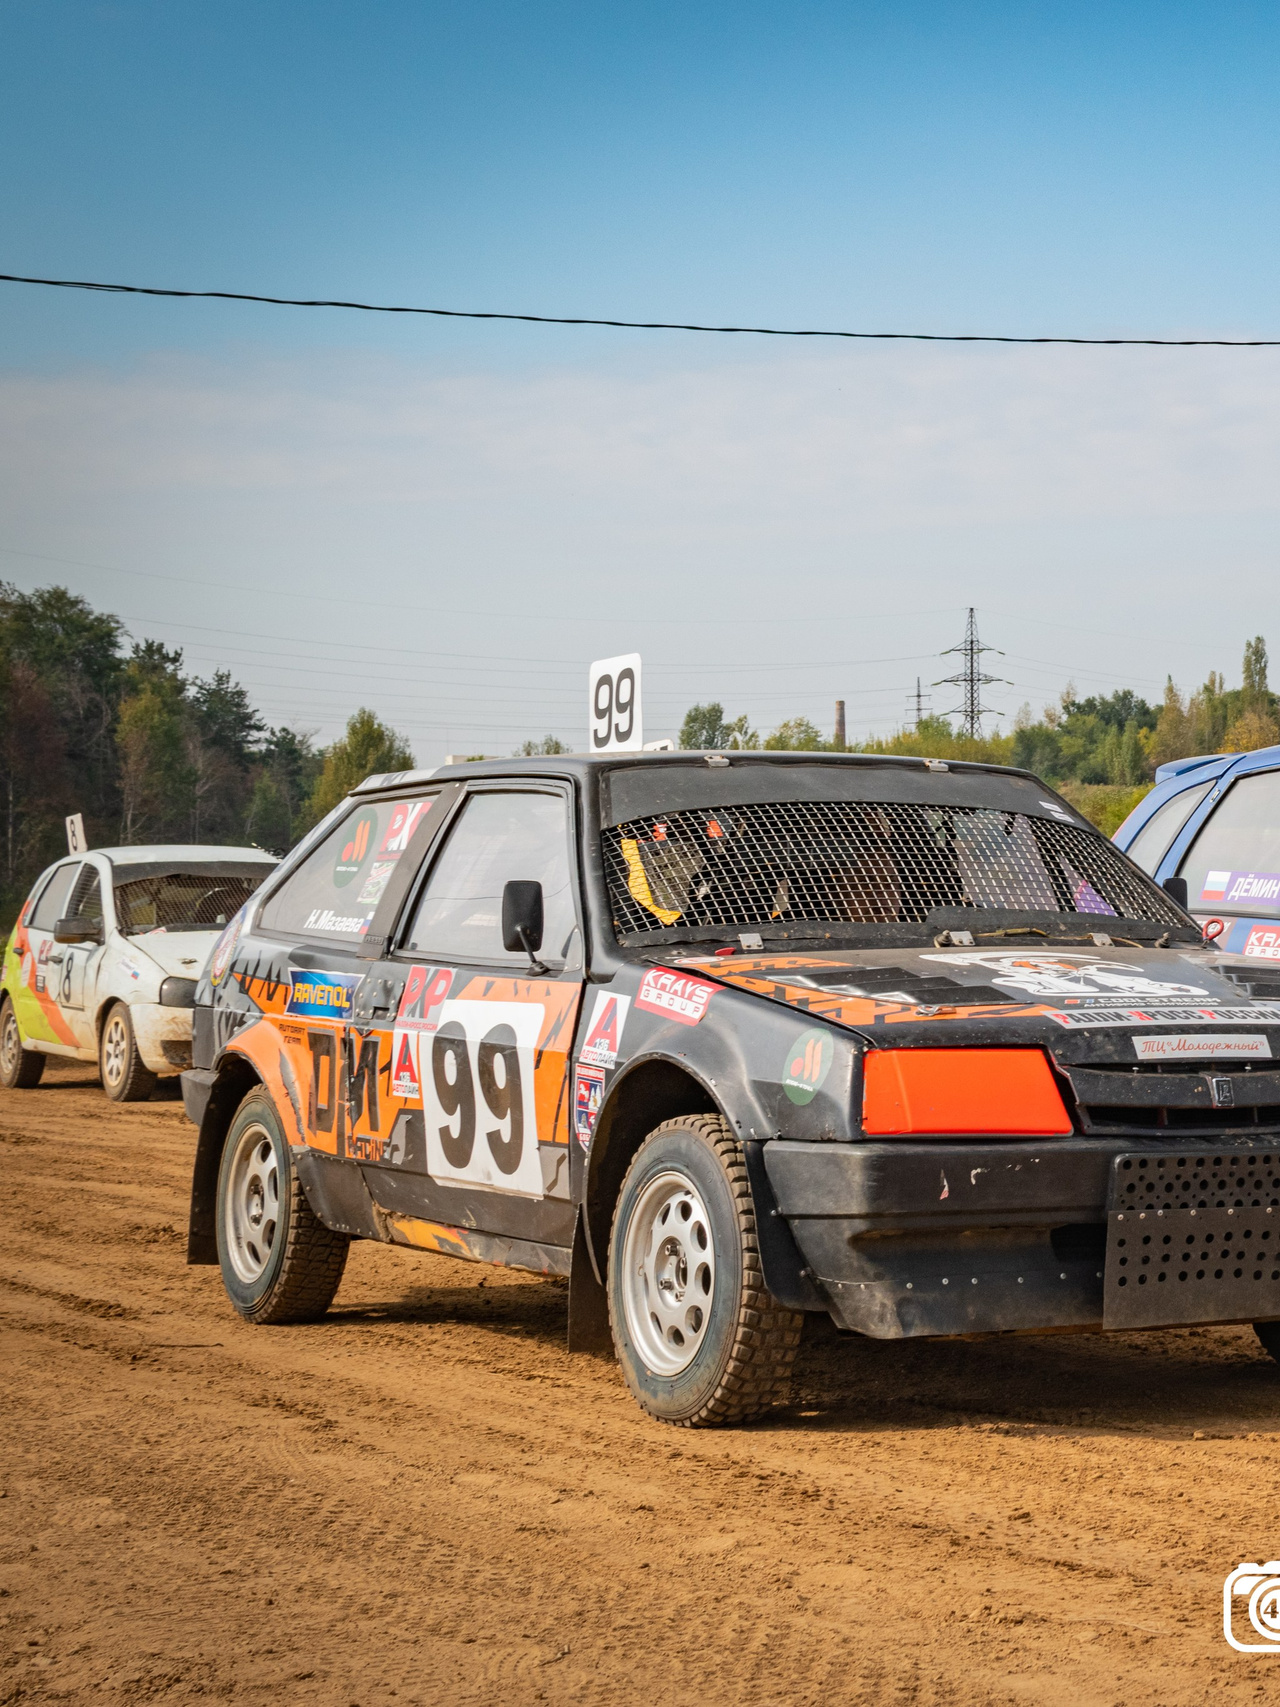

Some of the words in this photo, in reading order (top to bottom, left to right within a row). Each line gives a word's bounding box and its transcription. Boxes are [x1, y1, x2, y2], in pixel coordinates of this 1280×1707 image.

[593, 667, 635, 749] 99
[70, 819, 78, 852] 8
[303, 909, 365, 933] Н.Мазаева
[62, 951, 75, 1004] 8
[643, 969, 714, 1004] KRAYS
[293, 982, 351, 1009] RAVENOL
[643, 989, 701, 1015] GROUP
[1051, 1010, 1202, 1025] РАЛЛИ-КРОСС
[1141, 1041, 1166, 1054] ТЦ
[432, 1020, 525, 1176] 99
